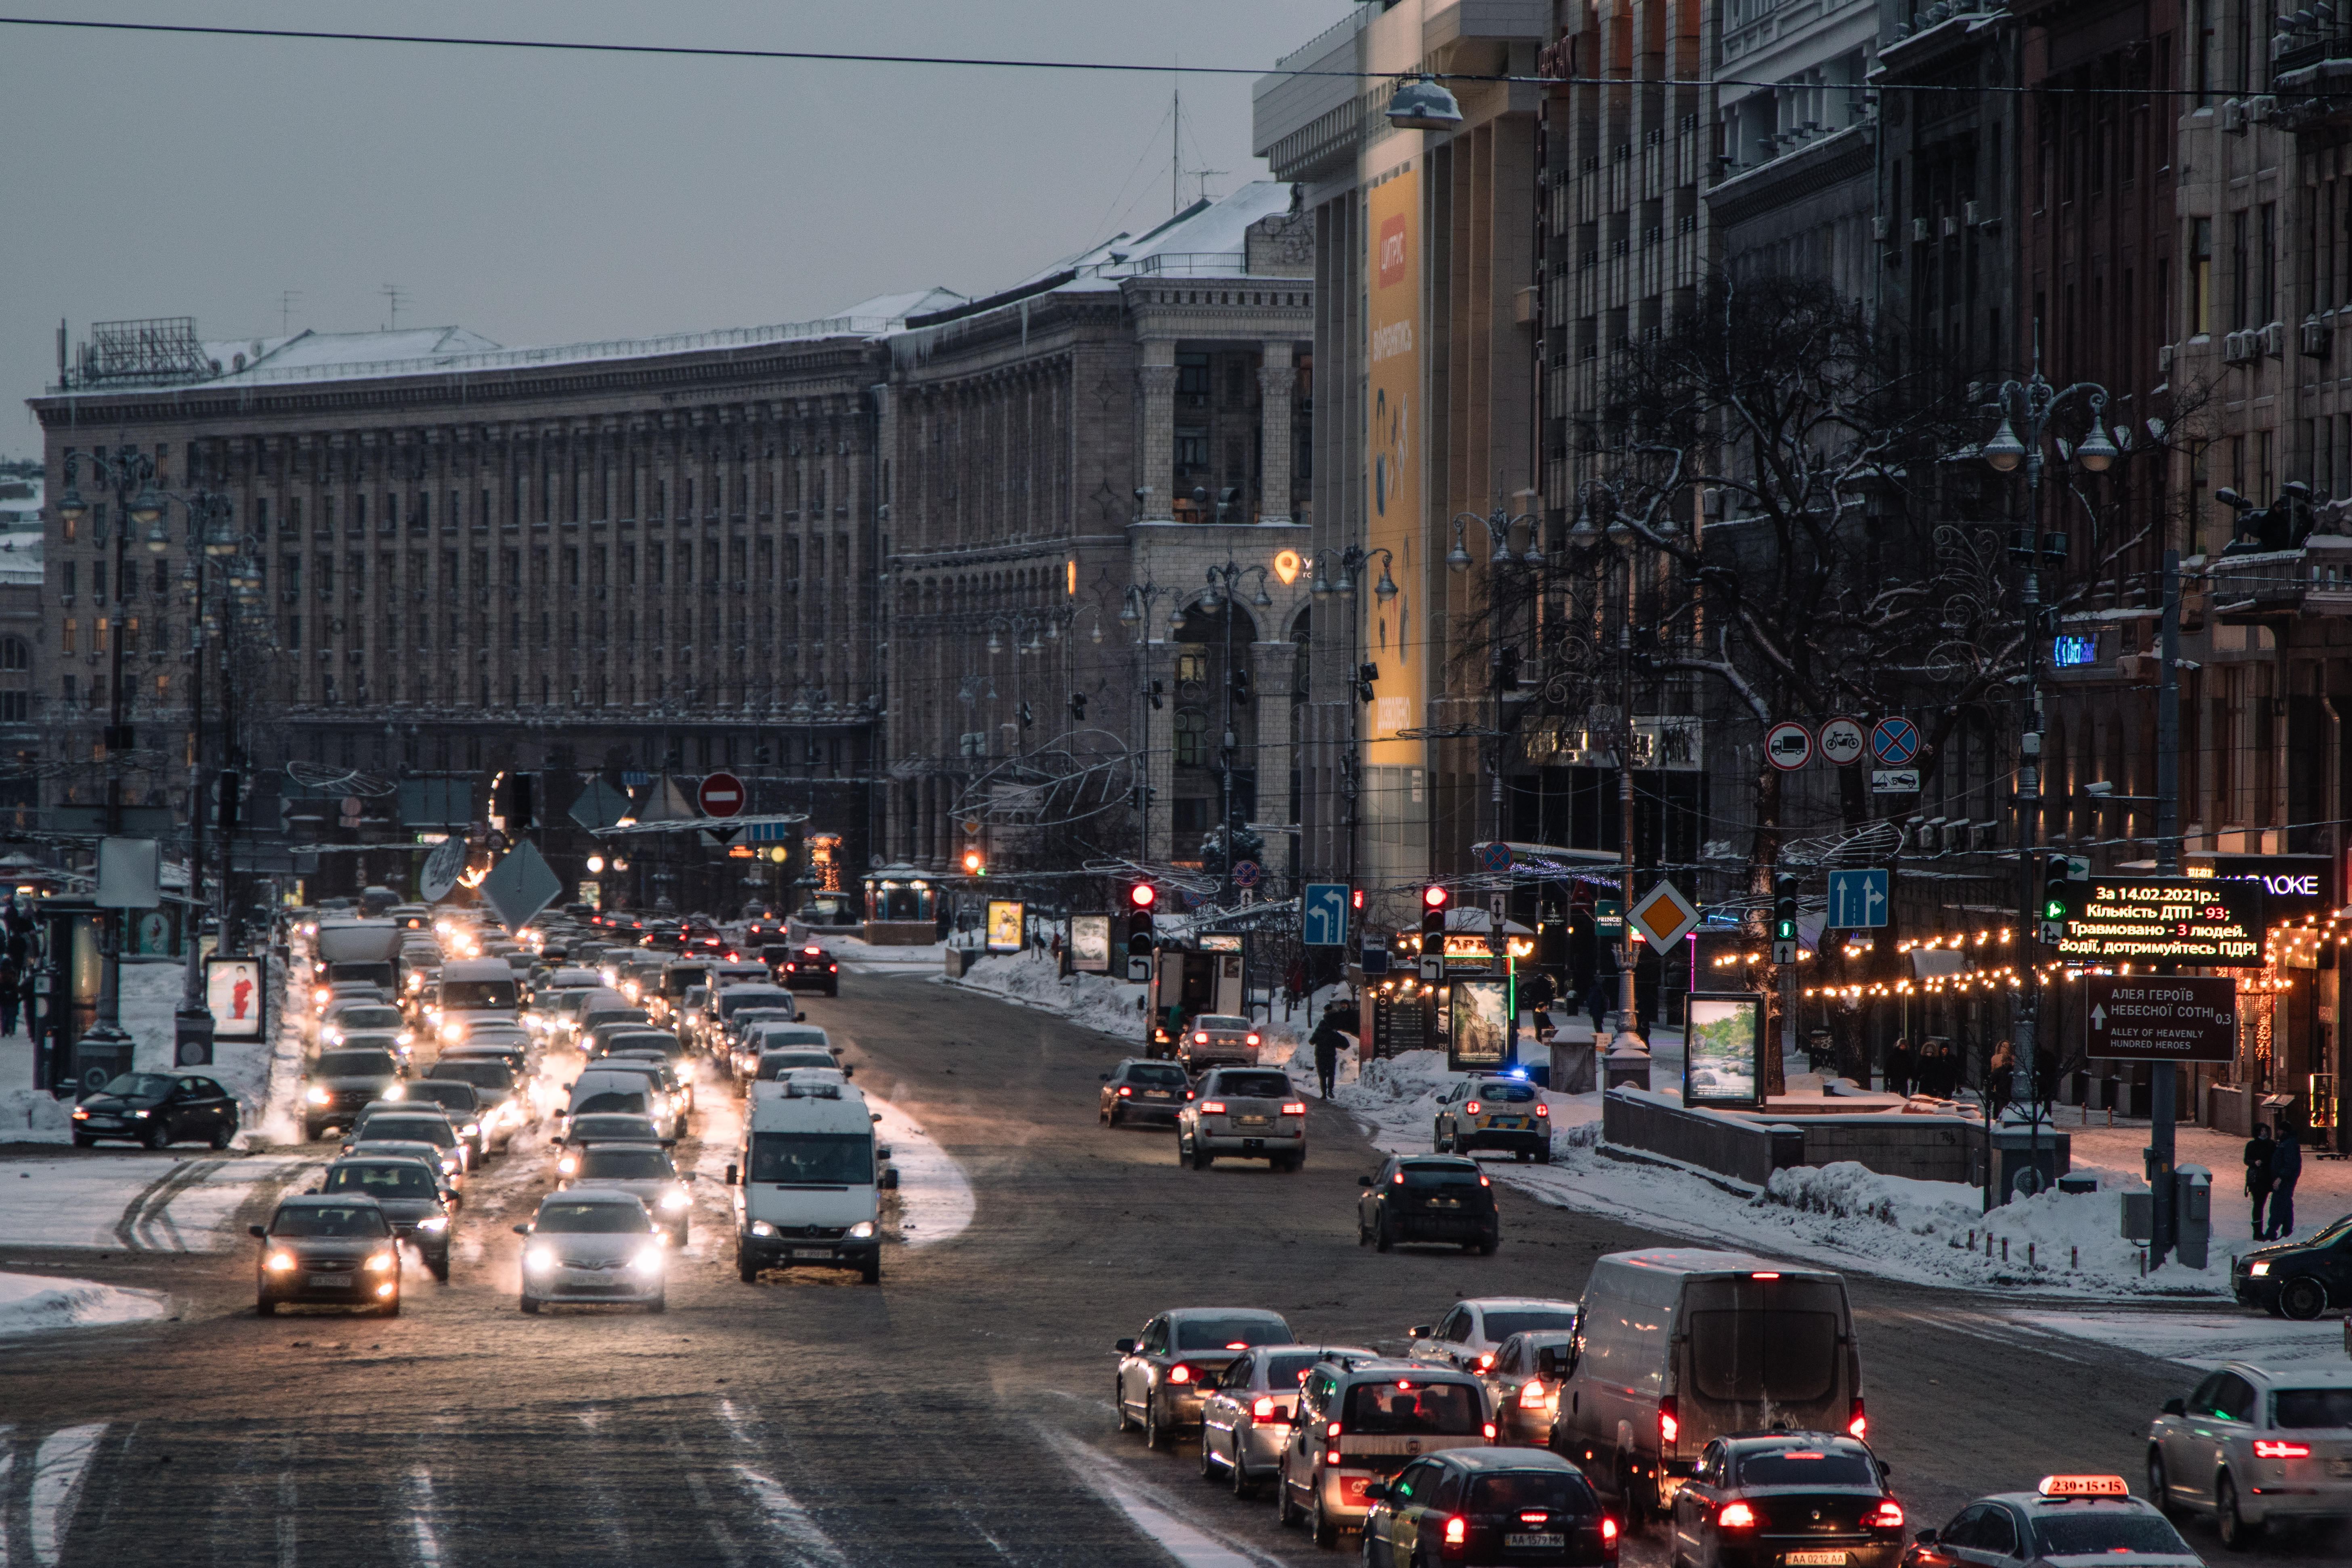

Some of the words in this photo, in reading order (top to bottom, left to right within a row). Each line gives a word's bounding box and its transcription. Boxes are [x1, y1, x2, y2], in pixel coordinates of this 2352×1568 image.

[2096, 887, 2115, 900] За
[2087, 904, 2158, 919] Кількість
[2159, 905, 2193, 921] ДТП
[2205, 907, 2230, 921] 93;
[2068, 921, 2165, 937] Травмовано
[2178, 924, 2187, 936] 3
[2190, 925, 2247, 939] людей.
[2103, 941, 2216, 956] дотримуйтесь
[2220, 942, 2258, 957] ПДР!
[2111, 989, 2144, 1000] АЛЕЯ
[2149, 988, 2194, 1001] ГЕРОЇВ
[2111, 1003, 2172, 1017] НЕБЕСНОЇ
[2178, 1007, 2214, 1018] СОТНІ
[2216, 1014, 2232, 1025] 0,3
[2111, 1028, 2138, 1036] ALLEY
[2142, 1029, 2153, 1037] OF
[2157, 1029, 2203, 1038] HEAVENLY
[2111, 1040, 2152, 1048] HUNDRED
[2155, 1041, 2191, 1050] HEROES
[1793, 1555, 1805, 1564] AA
[1808, 1555, 1828, 1564] 0212
[1831, 1555, 1844, 1564] AA
